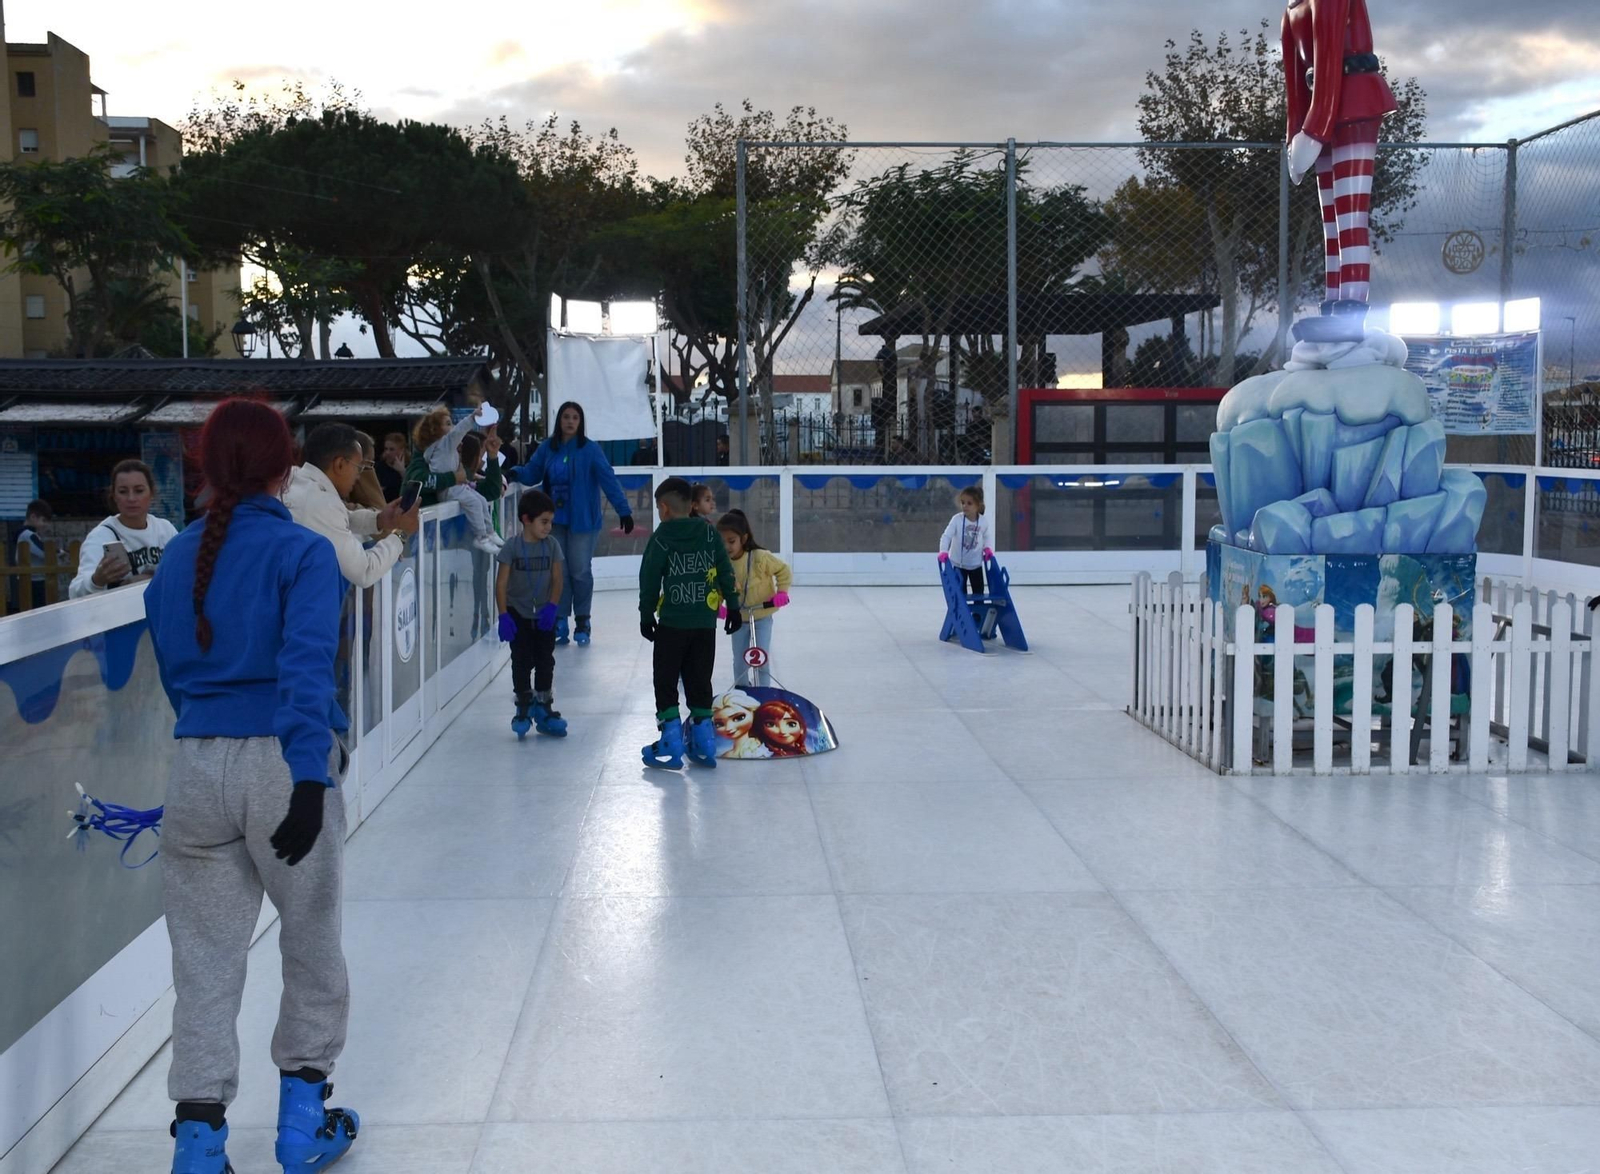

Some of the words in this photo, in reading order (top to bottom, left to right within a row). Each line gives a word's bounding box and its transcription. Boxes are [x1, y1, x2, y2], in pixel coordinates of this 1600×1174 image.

[668, 551, 716, 576] MEAN
[669, 582, 706, 604] ONE
[749, 650, 761, 664] 2
